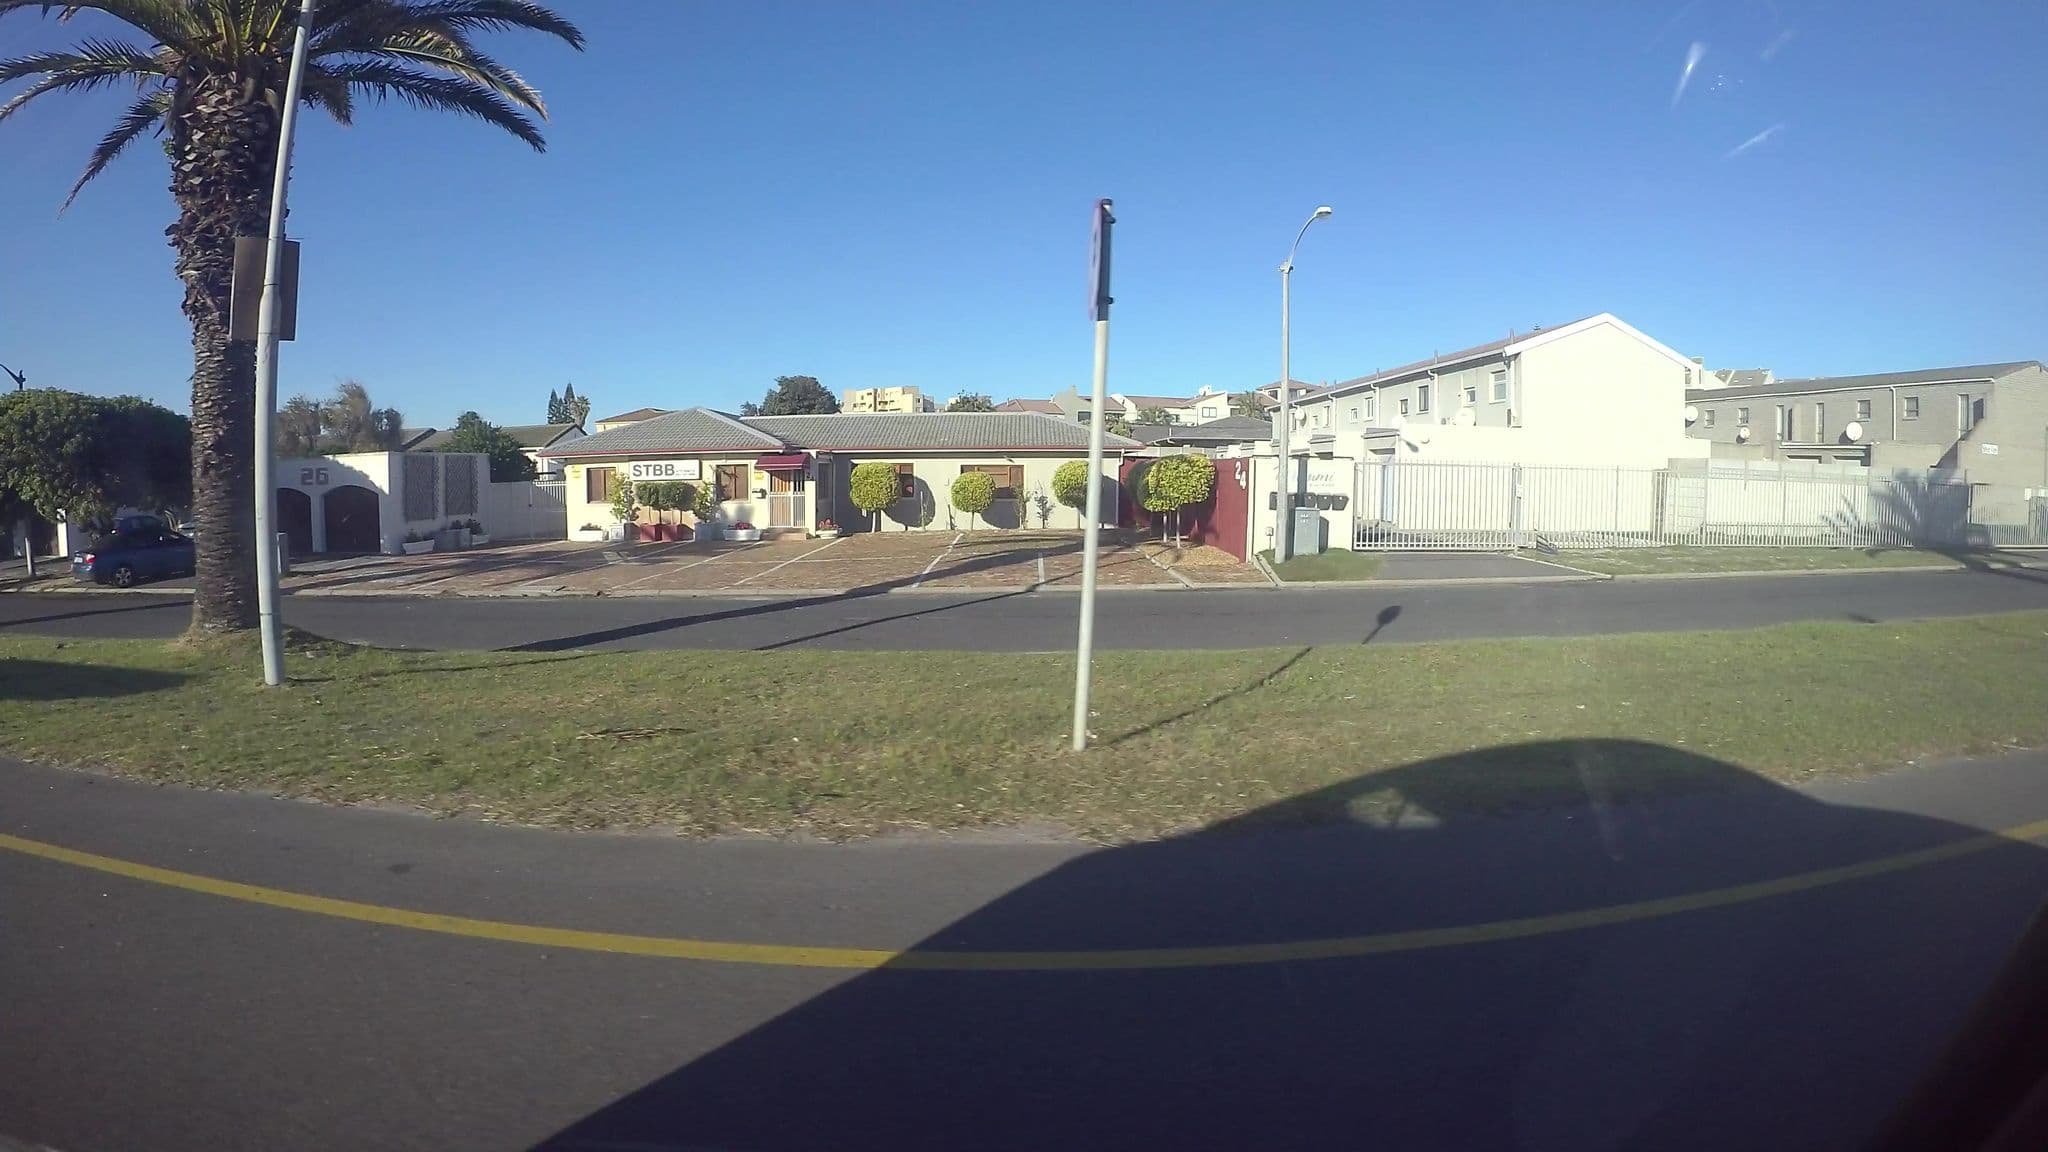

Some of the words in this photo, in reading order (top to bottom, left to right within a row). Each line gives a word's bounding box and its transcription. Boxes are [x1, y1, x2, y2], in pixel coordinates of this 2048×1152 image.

[301, 467, 329, 485] 26
[632, 464, 675, 477] STBB
[1234, 460, 1247, 490] 24
